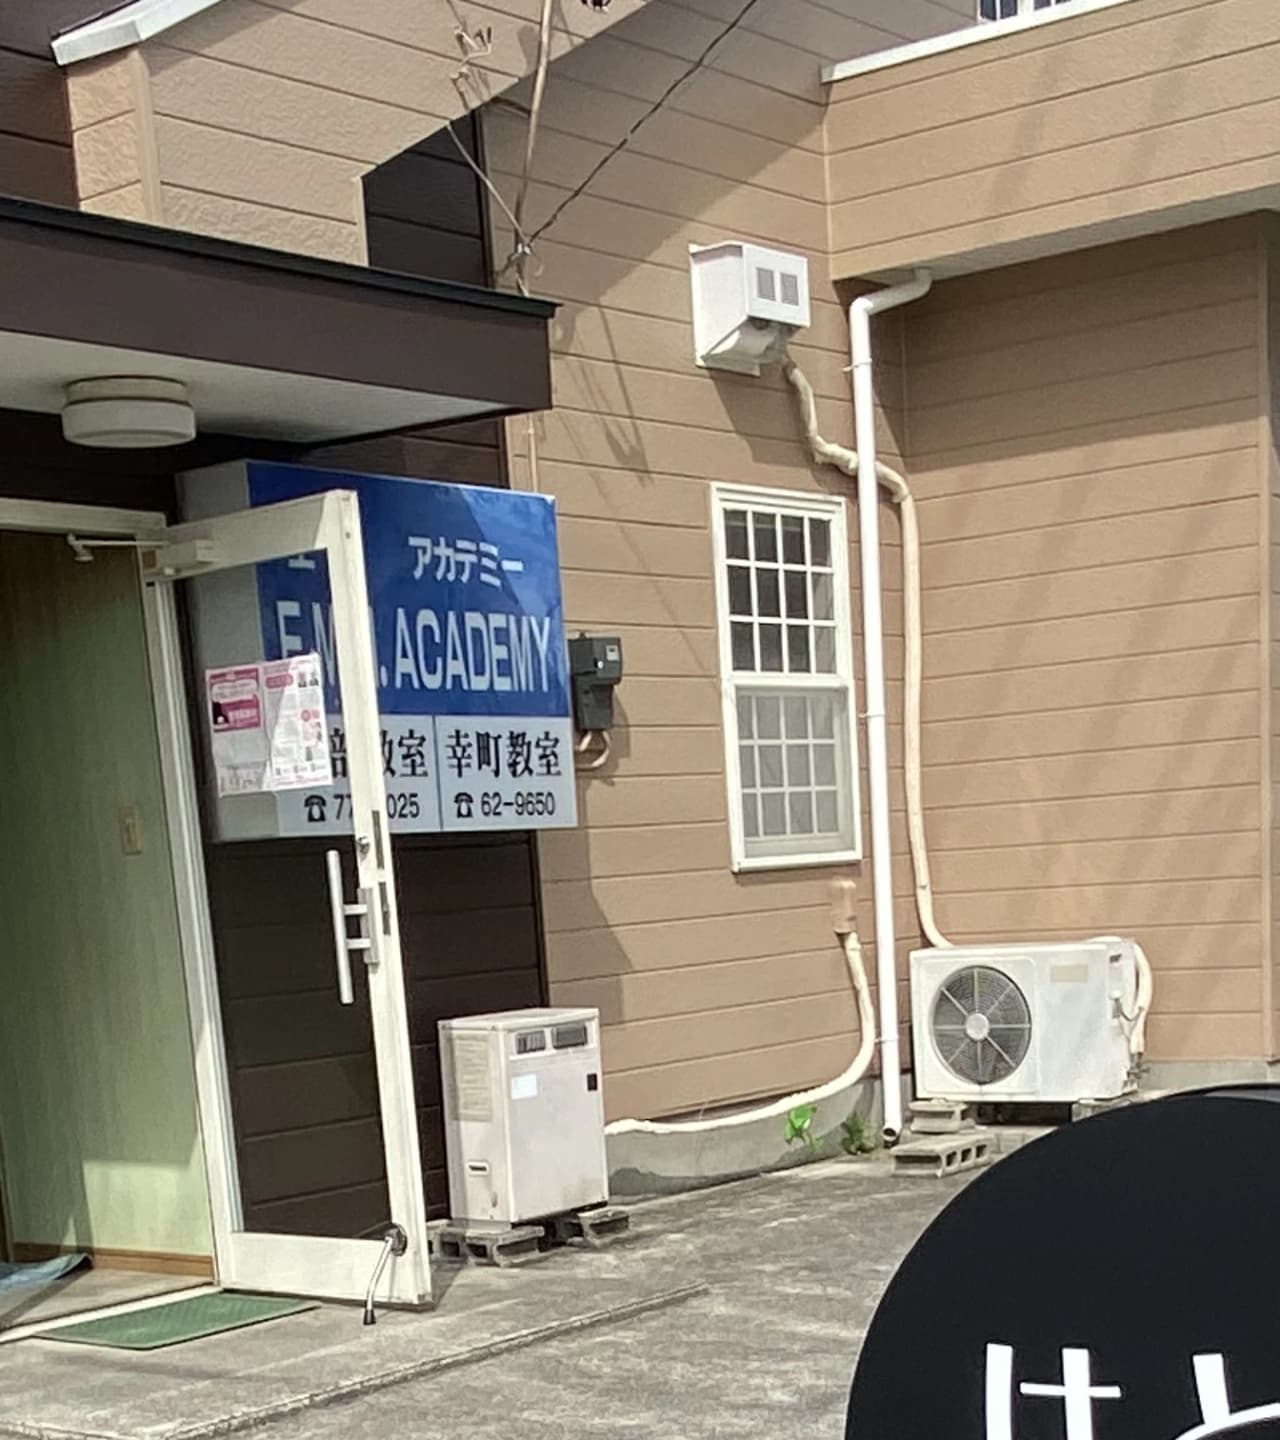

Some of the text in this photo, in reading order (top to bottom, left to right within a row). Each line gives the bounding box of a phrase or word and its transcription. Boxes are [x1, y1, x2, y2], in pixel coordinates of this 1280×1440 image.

[407, 535, 524, 588] アカデミー
[394, 606, 551, 694] ACADEMY
[446, 729, 562, 778] 幸町教室
[480, 792, 556, 817] 62-9650
